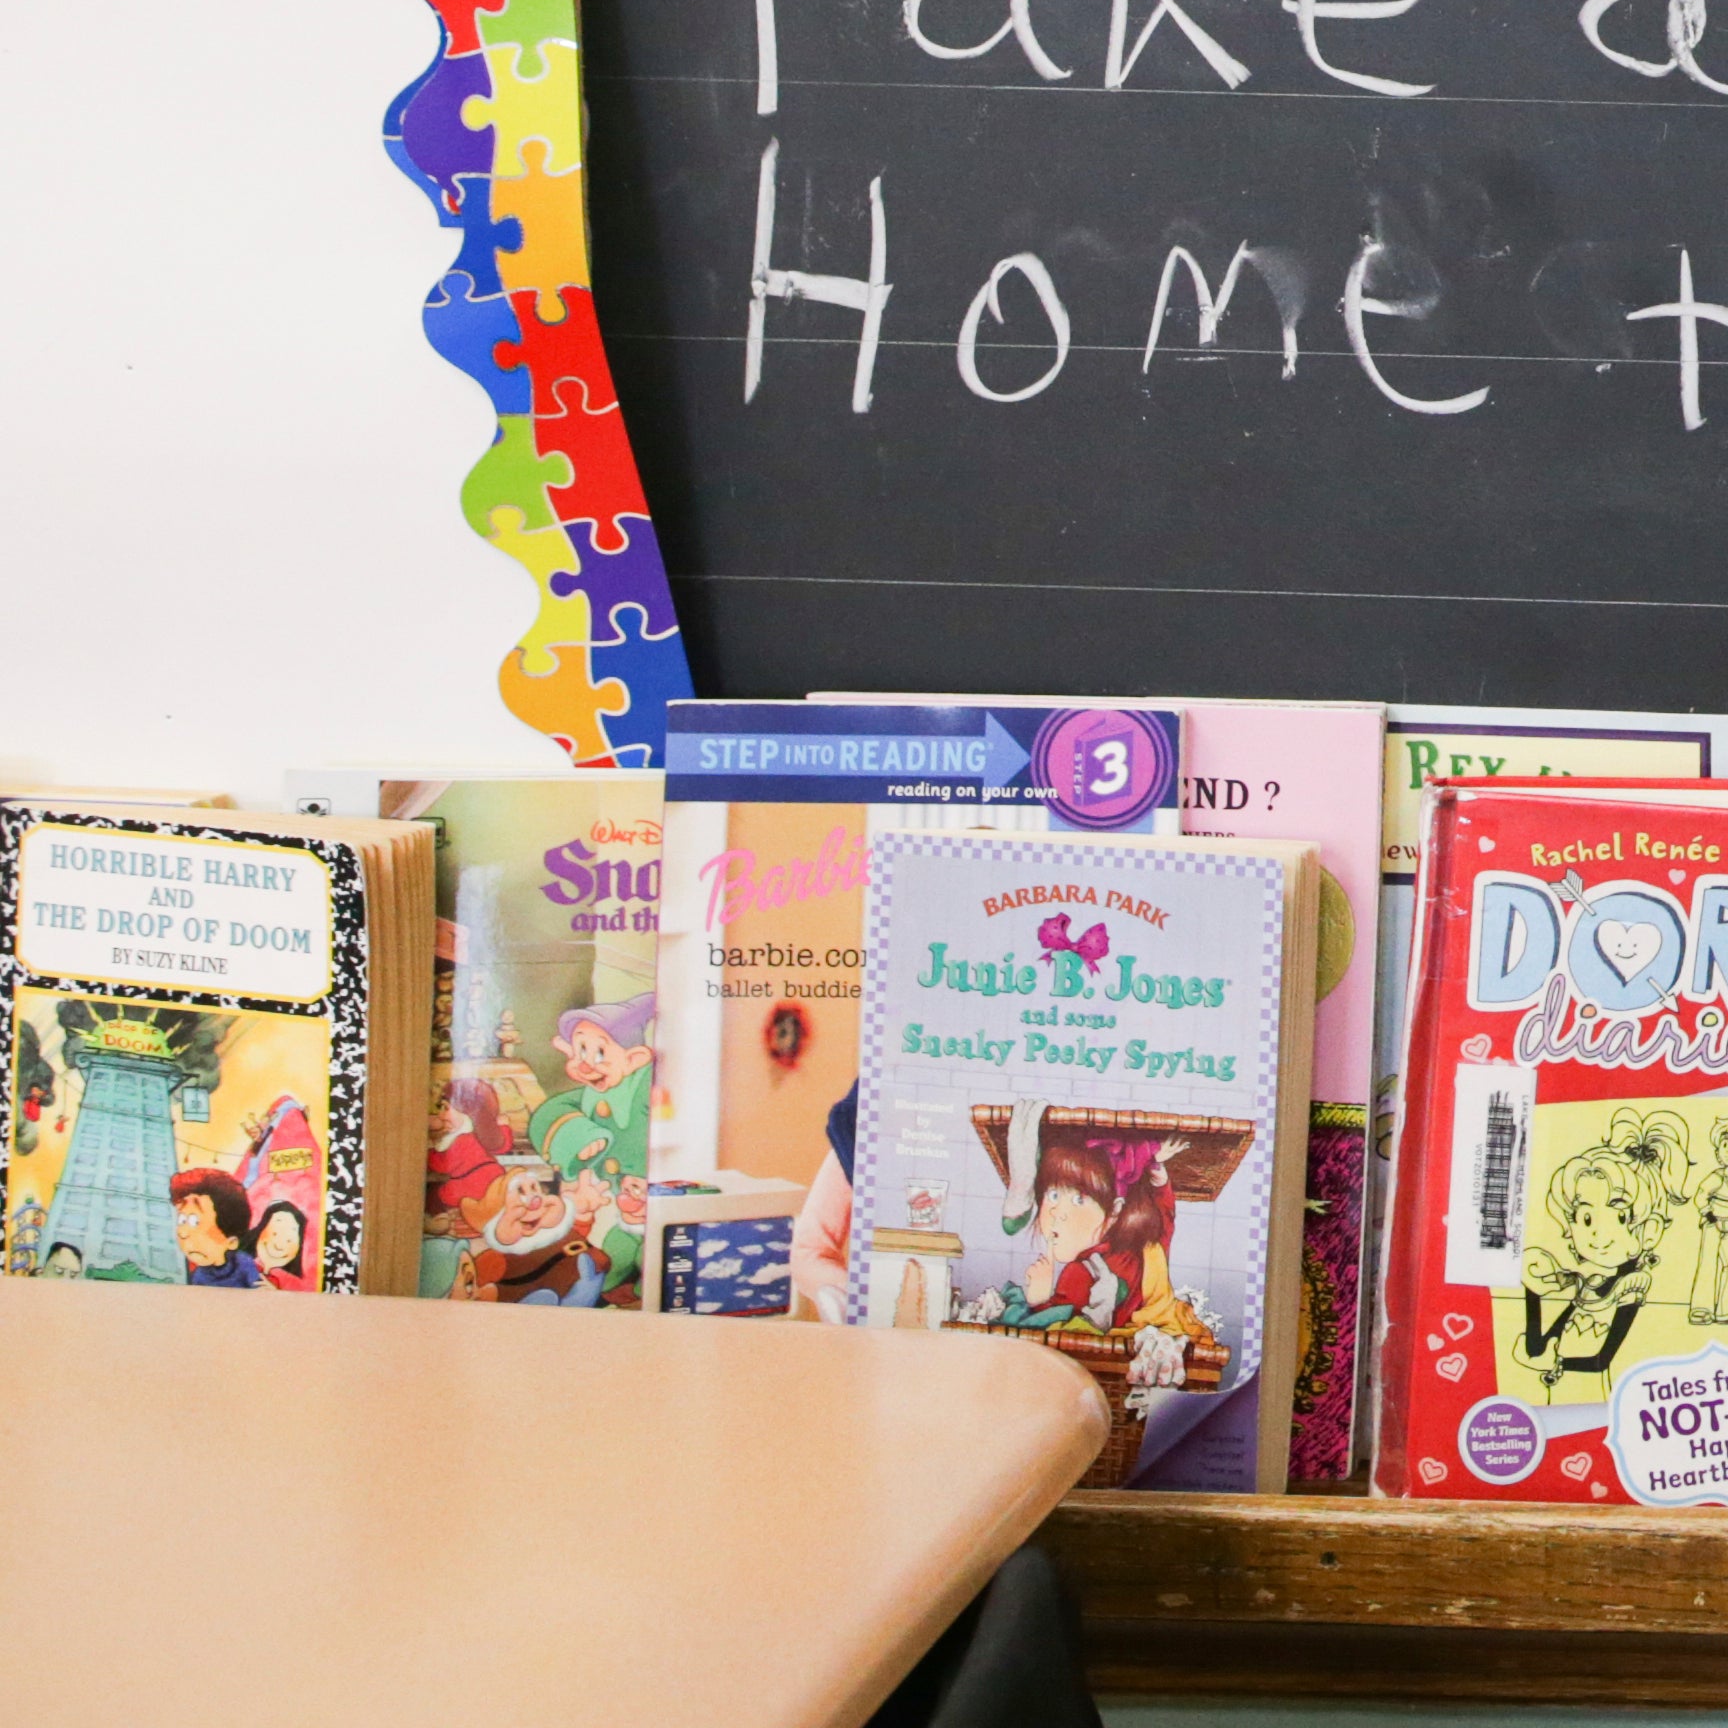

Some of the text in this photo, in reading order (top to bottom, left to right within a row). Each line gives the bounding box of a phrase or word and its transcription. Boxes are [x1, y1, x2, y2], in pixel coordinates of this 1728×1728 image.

[744, 137, 1491, 417] Home
[699, 739, 987, 772] STEP INTO READING
[1089, 740, 1130, 795] 3
[1073, 752, 1083, 795] STEP
[888, 782, 1059, 802] reading on your own
[1530, 832, 1624, 868] Rachel
[1634, 832, 1720, 863] Renée
[50, 844, 296, 892] HORRIBLE HARRY
[149, 886, 193, 909] AND
[982, 883, 1171, 931] BARBARA PARK
[34, 902, 311, 953] THE DROP OF DOOM
[570, 906, 627, 934] and
[112, 947, 228, 974] BY SUZY KLINE
[705, 980, 773, 998] ballet
[917, 941, 1226, 1010] Junie B. Jones
[1019, 1004, 1117, 1029] and some
[104, 1033, 164, 1053] DOOM
[901, 1022, 1237, 1082] Sneaky Peeky Spying
[1642, 1380, 1707, 1403] Tales
[1487, 1411, 1512, 1423] New
[1471, 1425, 1530, 1438] York Times
[1471, 1440, 1532, 1452] Bestselling
[1485, 1454, 1519, 1465] Series
